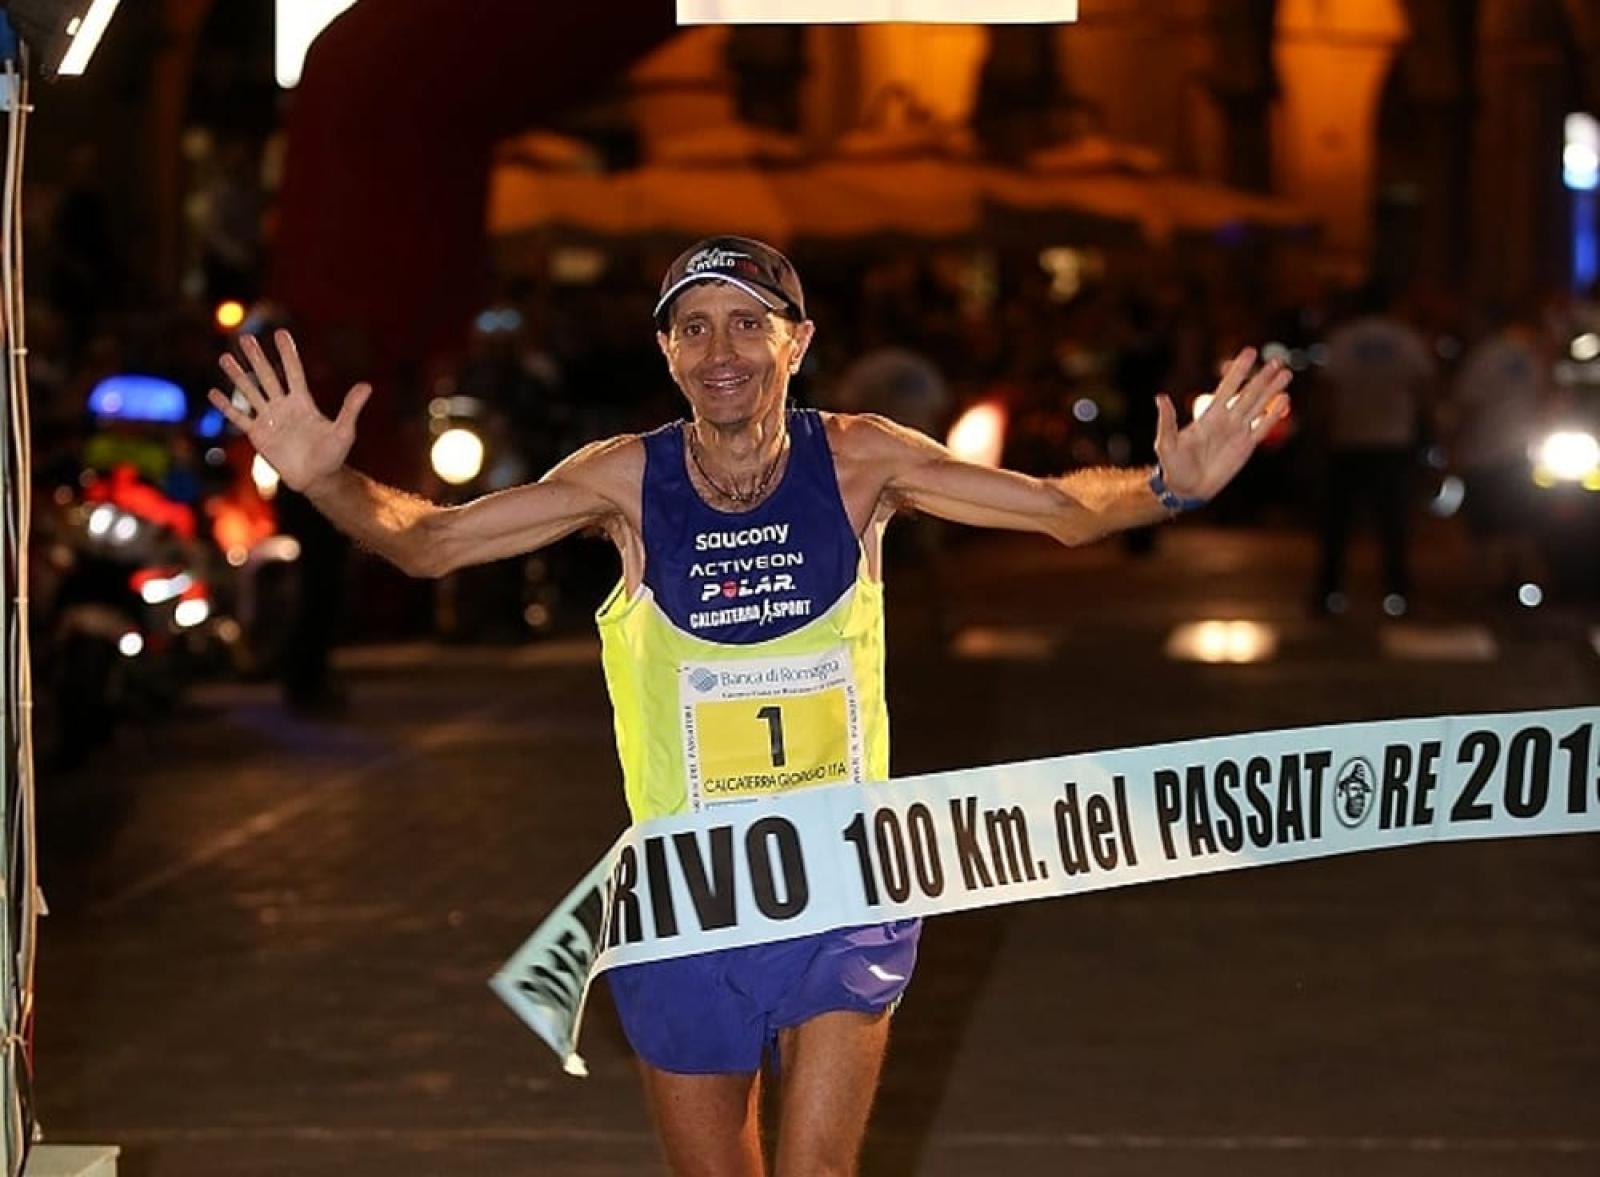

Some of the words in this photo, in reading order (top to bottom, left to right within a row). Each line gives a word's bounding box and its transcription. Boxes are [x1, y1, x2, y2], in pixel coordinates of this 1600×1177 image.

[695, 523, 789, 551] saucony
[689, 551, 804, 578] ACTIVEON
[773, 599, 812, 618] SPORT
[721, 671, 762, 688] Banca
[765, 667, 779, 683] di
[780, 660, 840, 682] Romagna
[756, 705, 786, 768] 1
[703, 775, 778, 794] CALCATERRA
[778, 766, 826, 788] GIORGIO
[827, 761, 849, 777] ITA
[601, 815, 810, 951] RIVO
[842, 801, 945, 907] 100
[948, 796, 1050, 891] Km.
[1053, 775, 1138, 877] del
[1449, 722, 1600, 823] 201
